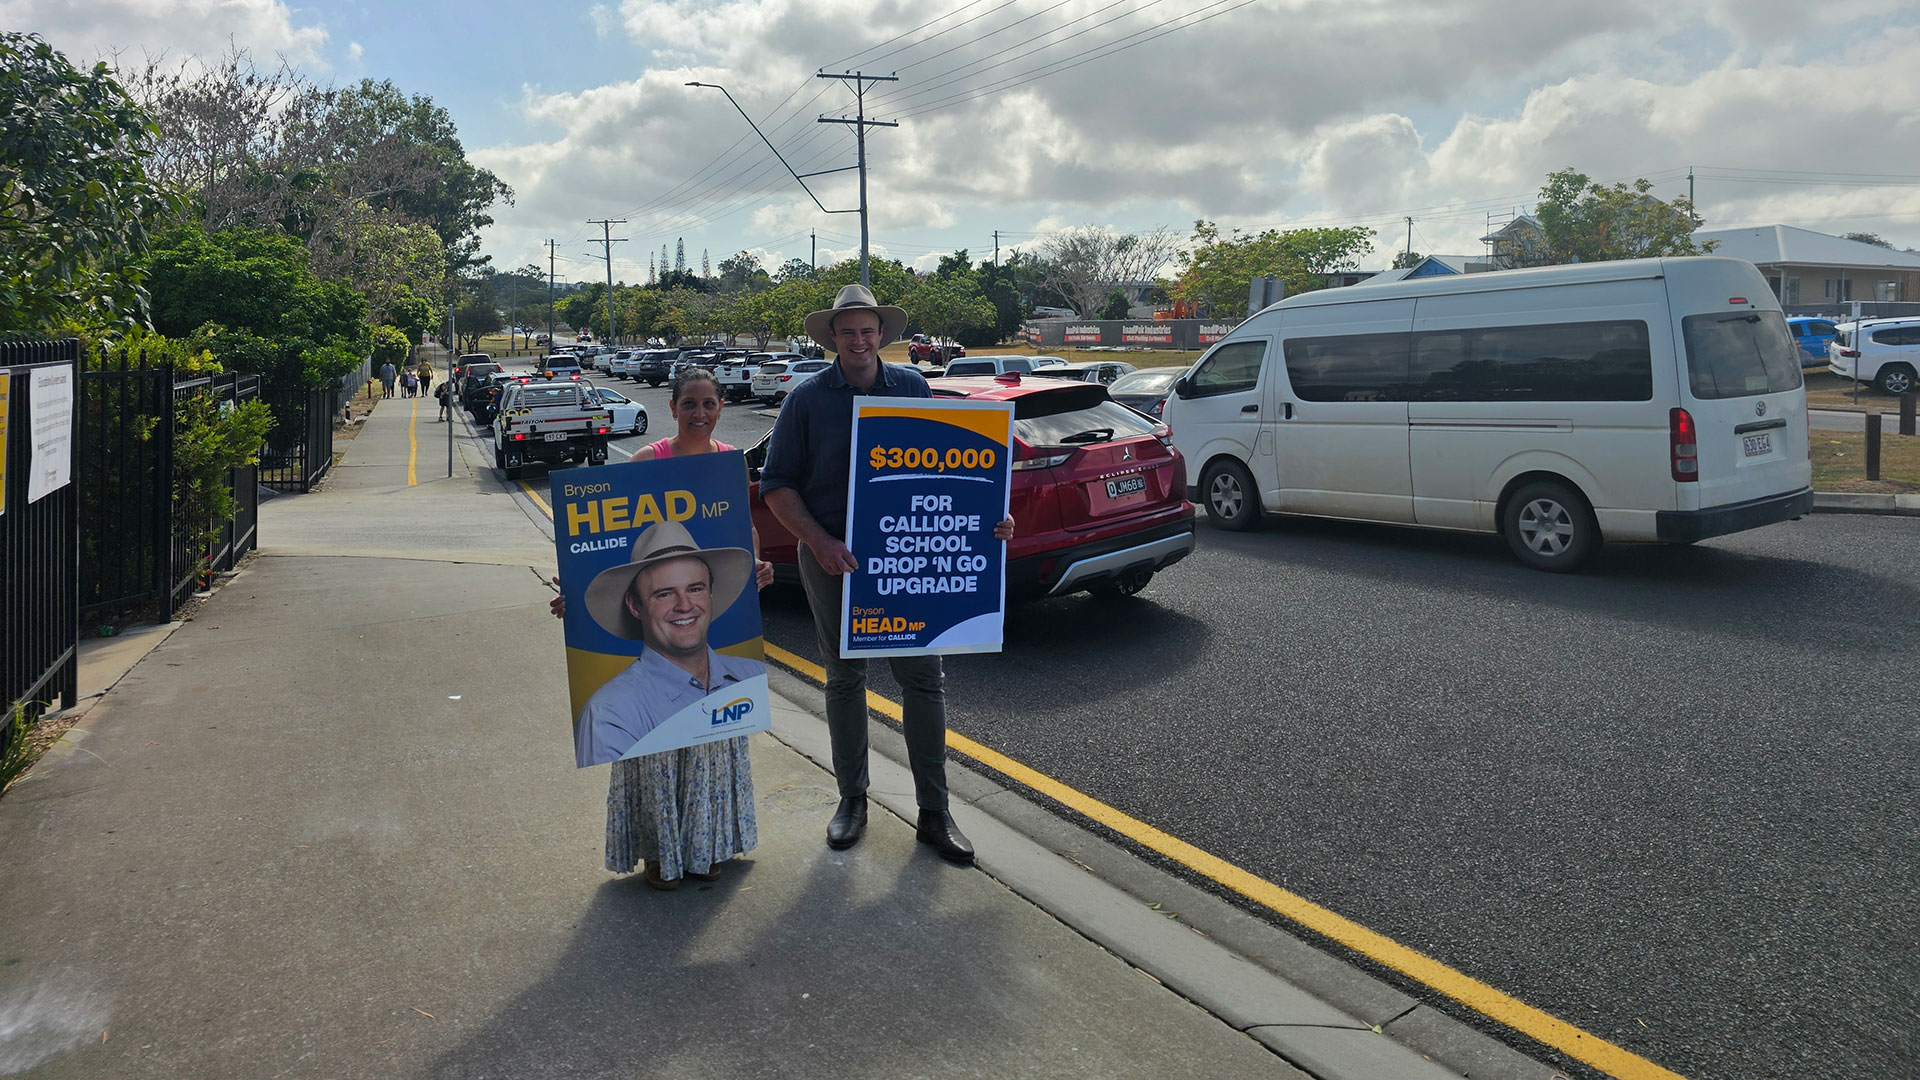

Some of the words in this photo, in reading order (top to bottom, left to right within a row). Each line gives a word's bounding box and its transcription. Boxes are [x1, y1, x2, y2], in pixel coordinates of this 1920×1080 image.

[1200, 324, 1227, 335] RoadPak
[870, 445, 996, 473] $300,000
[1100, 468, 1135, 479] ECLIPSE
[564, 482, 611, 498] Bryson
[566, 489, 697, 536] HEAD
[702, 501, 730, 519] MP
[911, 495, 953, 512] FOR
[879, 515, 981, 533] CALLIOPE
[570, 536, 628, 554] CALLIDE
[885, 535, 972, 553] SCHOOL
[868, 556, 927, 575] DROP
[956, 555, 987, 572] GO
[877, 575, 978, 595] UPGRADE
[852, 606, 885, 617] Bryson
[852, 617, 907, 634] HEAD
[908, 622, 926, 632] MP
[888, 633, 917, 641] CALLIDE
[711, 703, 750, 726] LNP
